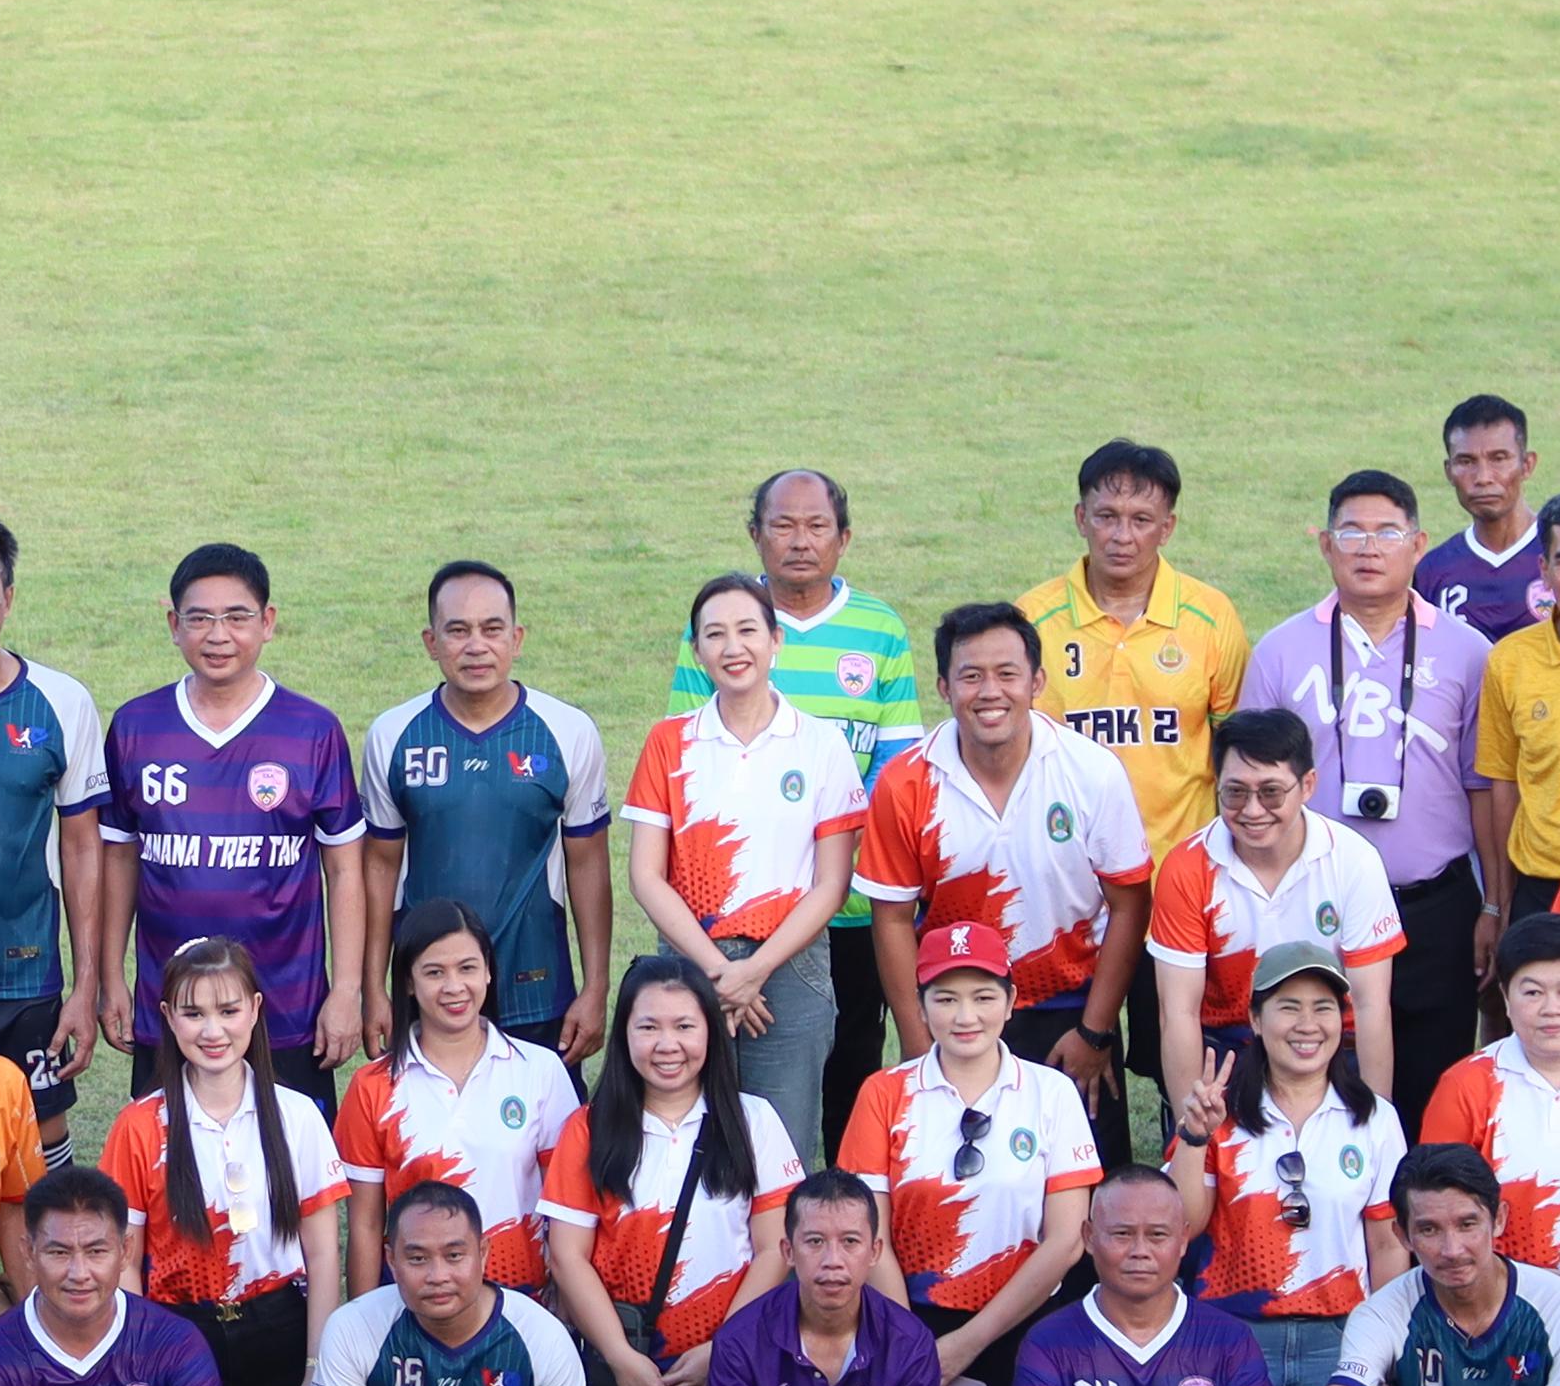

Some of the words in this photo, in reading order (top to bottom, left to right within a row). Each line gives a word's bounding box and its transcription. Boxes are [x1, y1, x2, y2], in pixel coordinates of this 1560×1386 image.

[1065, 642, 1084, 678] 3
[1066, 708, 1141, 746] TAK
[1153, 708, 1179, 746] 2
[1292, 663, 1449, 760] NBT
[141, 763, 188, 807] 66
[404, 745, 449, 788] 50
[208, 836, 265, 871] TREE
[269, 835, 307, 869] TAK
